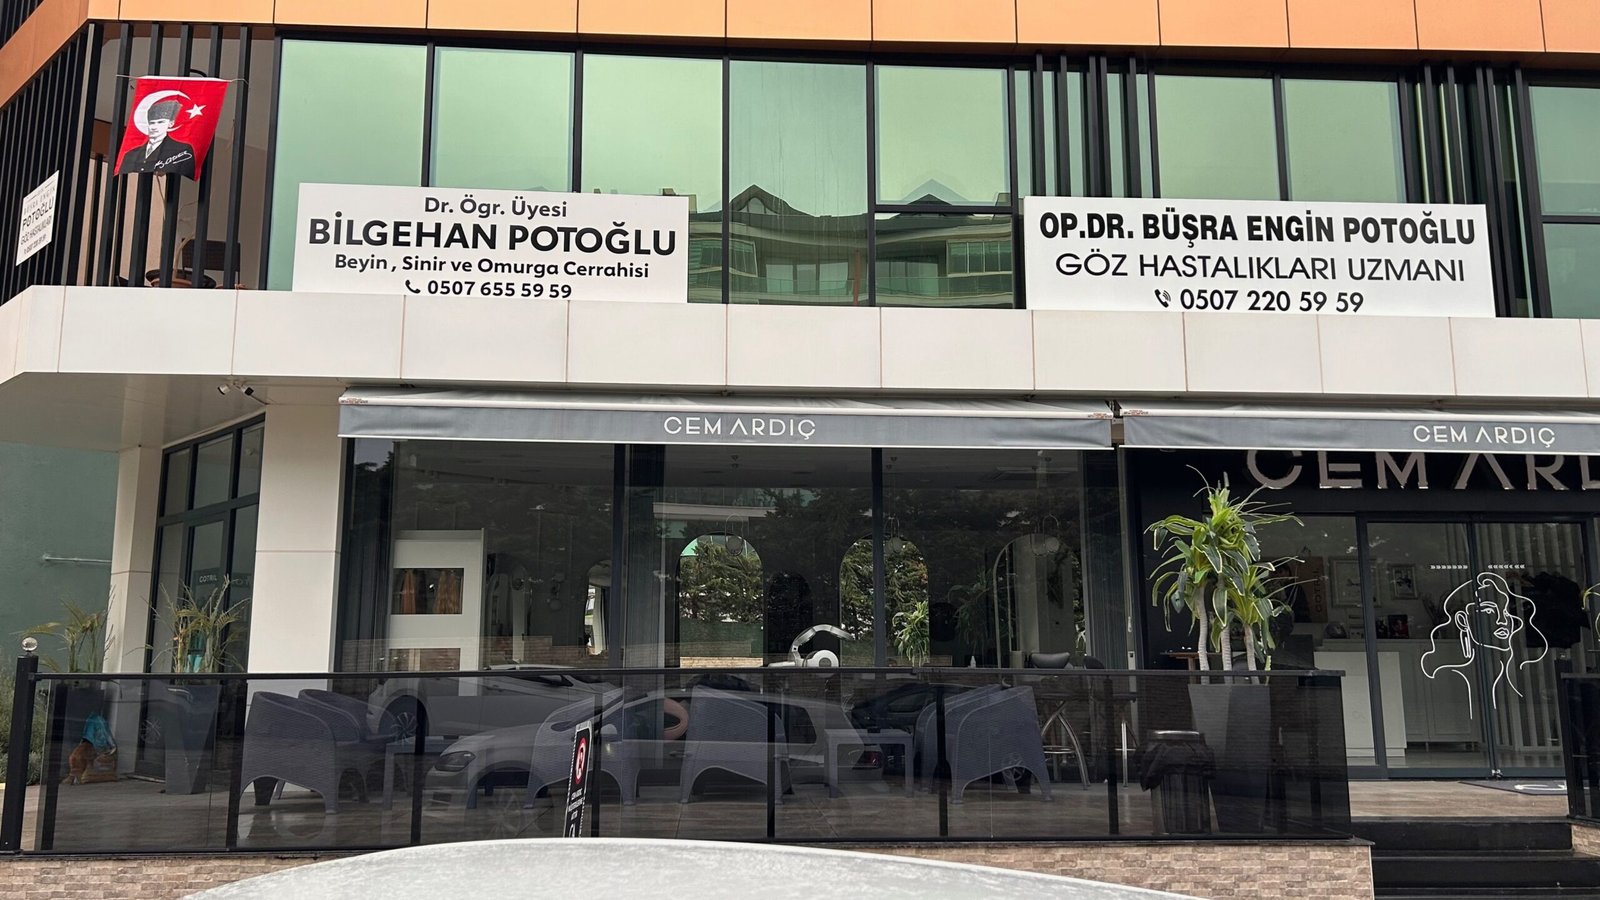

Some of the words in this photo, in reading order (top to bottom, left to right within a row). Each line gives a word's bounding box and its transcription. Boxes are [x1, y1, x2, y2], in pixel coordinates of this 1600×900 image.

[424, 197, 454, 213] Dr.
[459, 194, 505, 219] Ögr.
[511, 196, 567, 220] Üyesi
[309, 211, 497, 250] BİLGEHAN
[508, 221, 676, 256] POTOĞLU
[1039, 212, 1134, 240] OP.DR.
[1142, 207, 1238, 248] BÜŞRA
[1247, 210, 1335, 243] ENGİN
[1343, 211, 1475, 245] POTOĞLU
[335, 253, 388, 273] Beyin
[402, 255, 447, 272] Sinir
[450, 260, 473, 273] ve
[477, 258, 559, 279] Omurga
[563, 261, 649, 278] Cerrahisi
[1055, 248, 1128, 277] GÖZ
[1139, 254, 1337, 280] HASTALIKLARI
[1347, 258, 1465, 282] UZMANI
[427, 280, 474, 296] 0507
[480, 282, 516, 297] 655
[520, 283, 544, 298] 59
[548, 284, 572, 299] 59
[1180, 288, 1239, 310] 0507
[1246, 290, 1291, 312] 220
[1299, 291, 1327, 312] 59
[1335, 292, 1364, 313] 59
[663, 416, 722, 435] CEM
[729, 417, 816, 441] ARDIÇ
[1413, 425, 1468, 444] CEM
[1475, 426, 1556, 449] ARDIÇ
[1247, 450, 1430, 489] CEM
